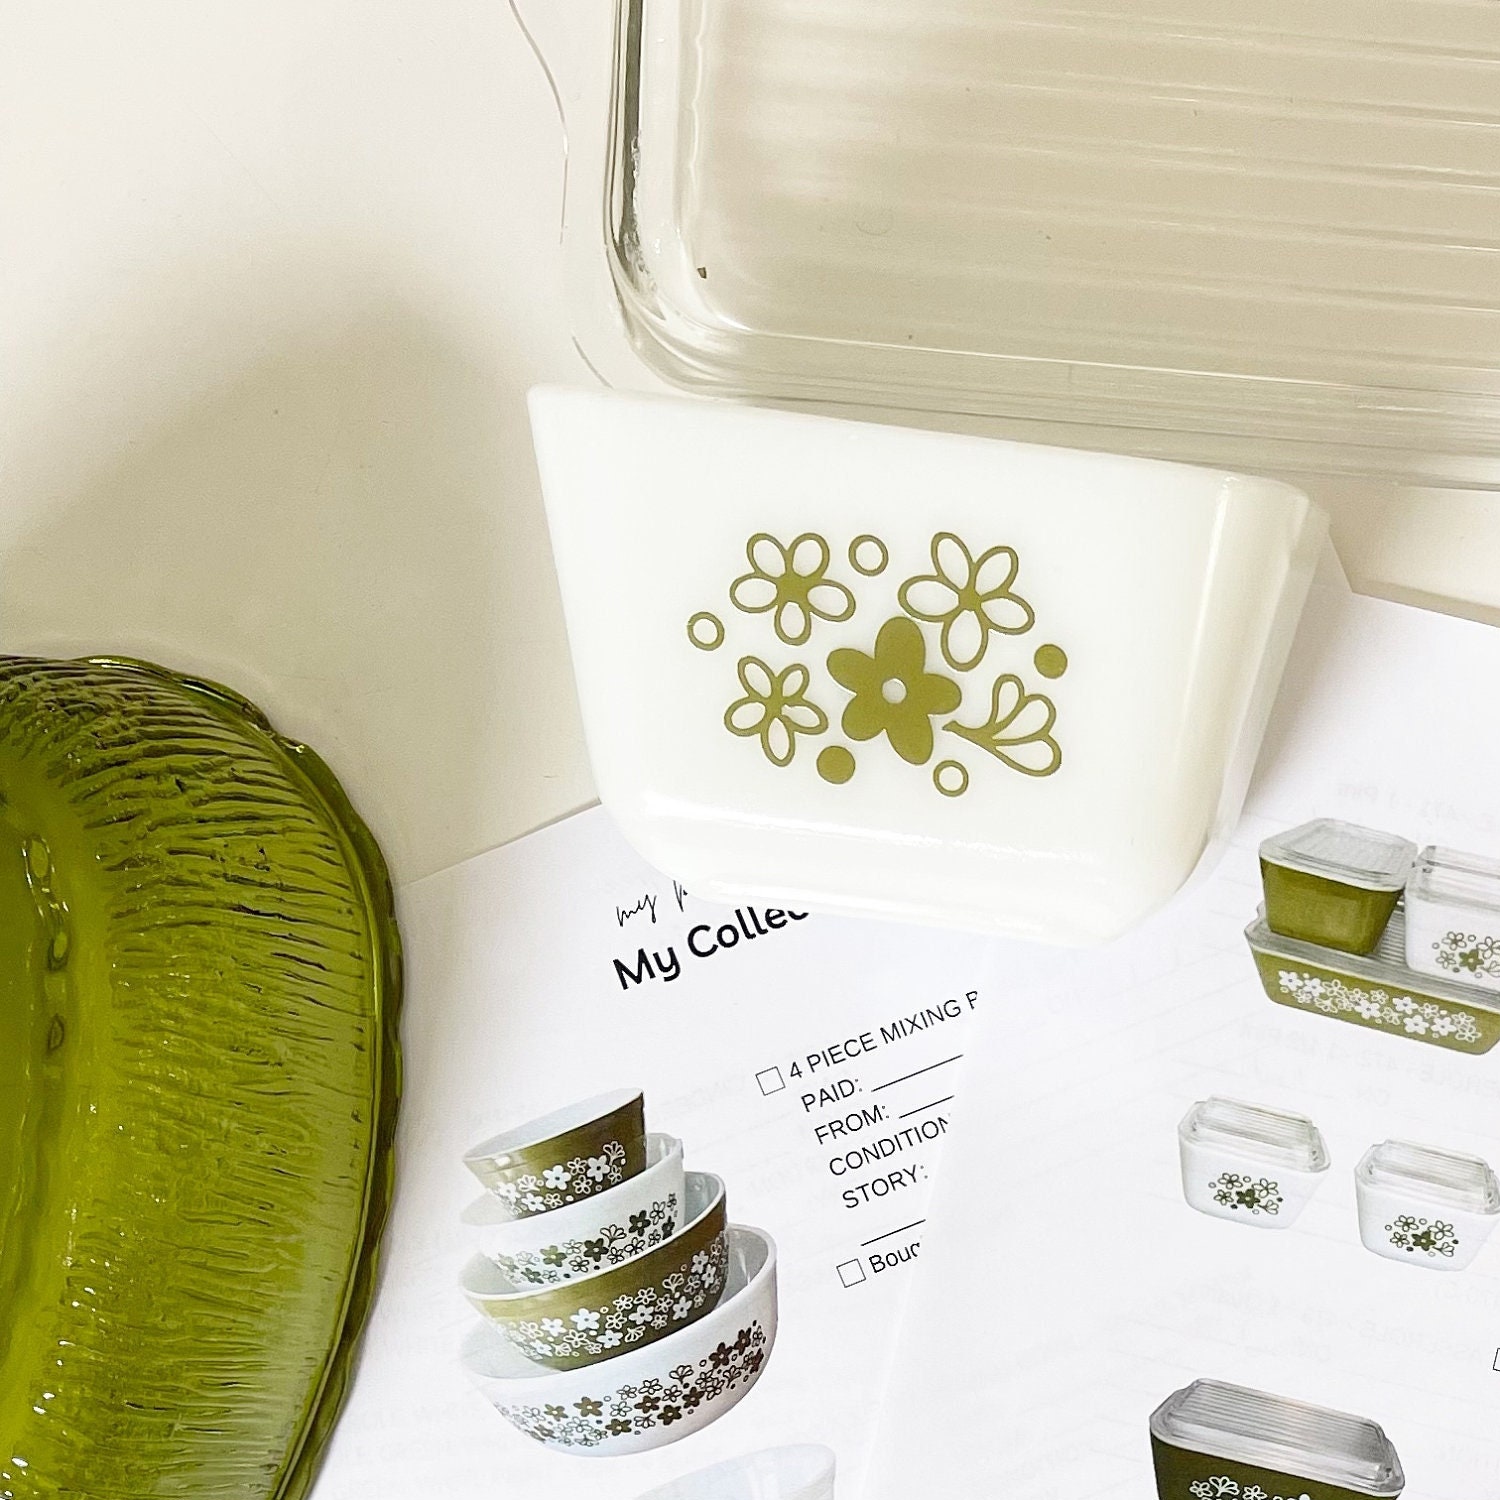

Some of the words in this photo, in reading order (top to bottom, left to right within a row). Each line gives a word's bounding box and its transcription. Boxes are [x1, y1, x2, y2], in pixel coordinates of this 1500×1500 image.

[615, 893, 658, 928] my
[612, 946, 682, 991] My
[789, 1061, 803, 1079] 4
[805, 1031, 878, 1074] PIECE
[879, 999, 962, 1045] MIXING
[800, 1078, 863, 1113] PAID:
[813, 1104, 890, 1146] FROM:
[842, 1163, 929, 1209] STORY:
